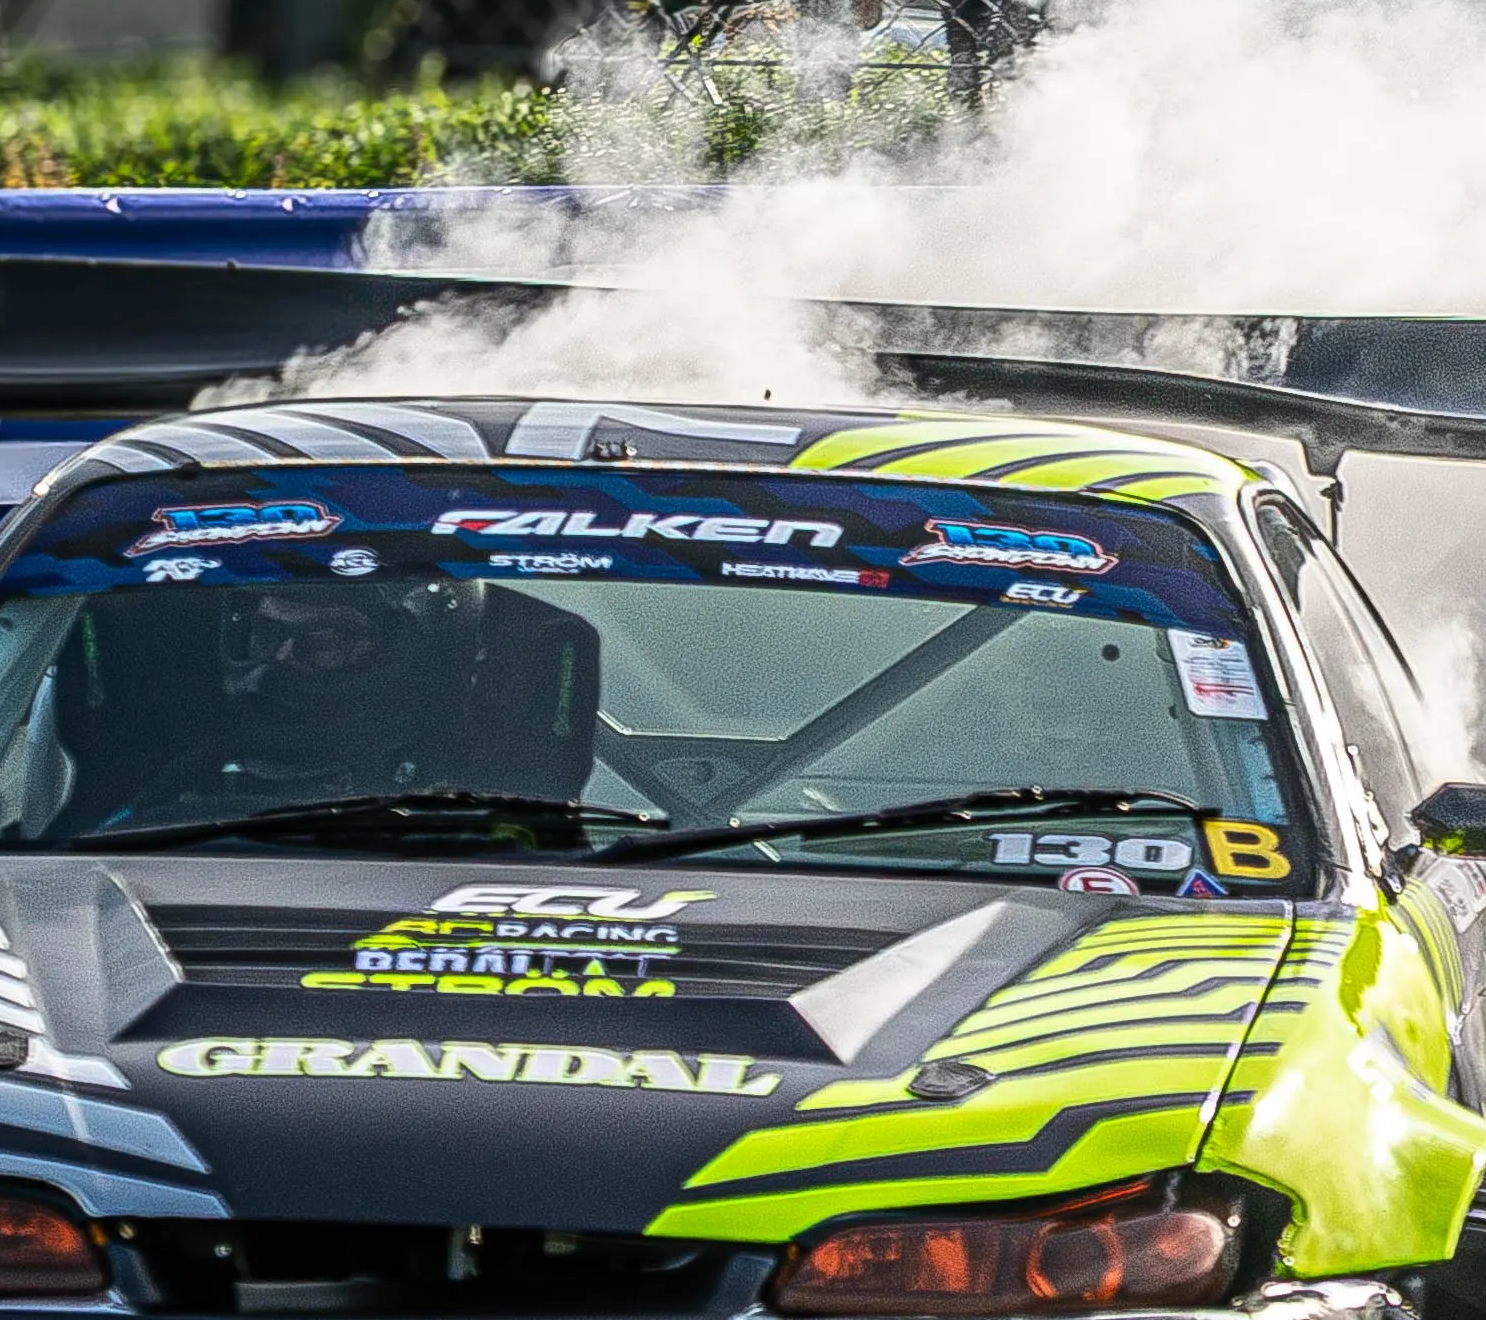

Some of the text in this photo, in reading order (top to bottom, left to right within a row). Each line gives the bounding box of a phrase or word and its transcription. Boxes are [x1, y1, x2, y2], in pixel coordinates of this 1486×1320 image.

[430, 510, 845, 548] FALKEN
[936, 524, 1096, 557] 130
[489, 552, 614, 568] STRÖM
[1005, 582, 1089, 604] ECU
[987, 833, 1193, 870] 130
[1203, 818, 1292, 879] B
[430, 885, 716, 918] ECU
[157, 1037, 782, 1097] GRANDAL
